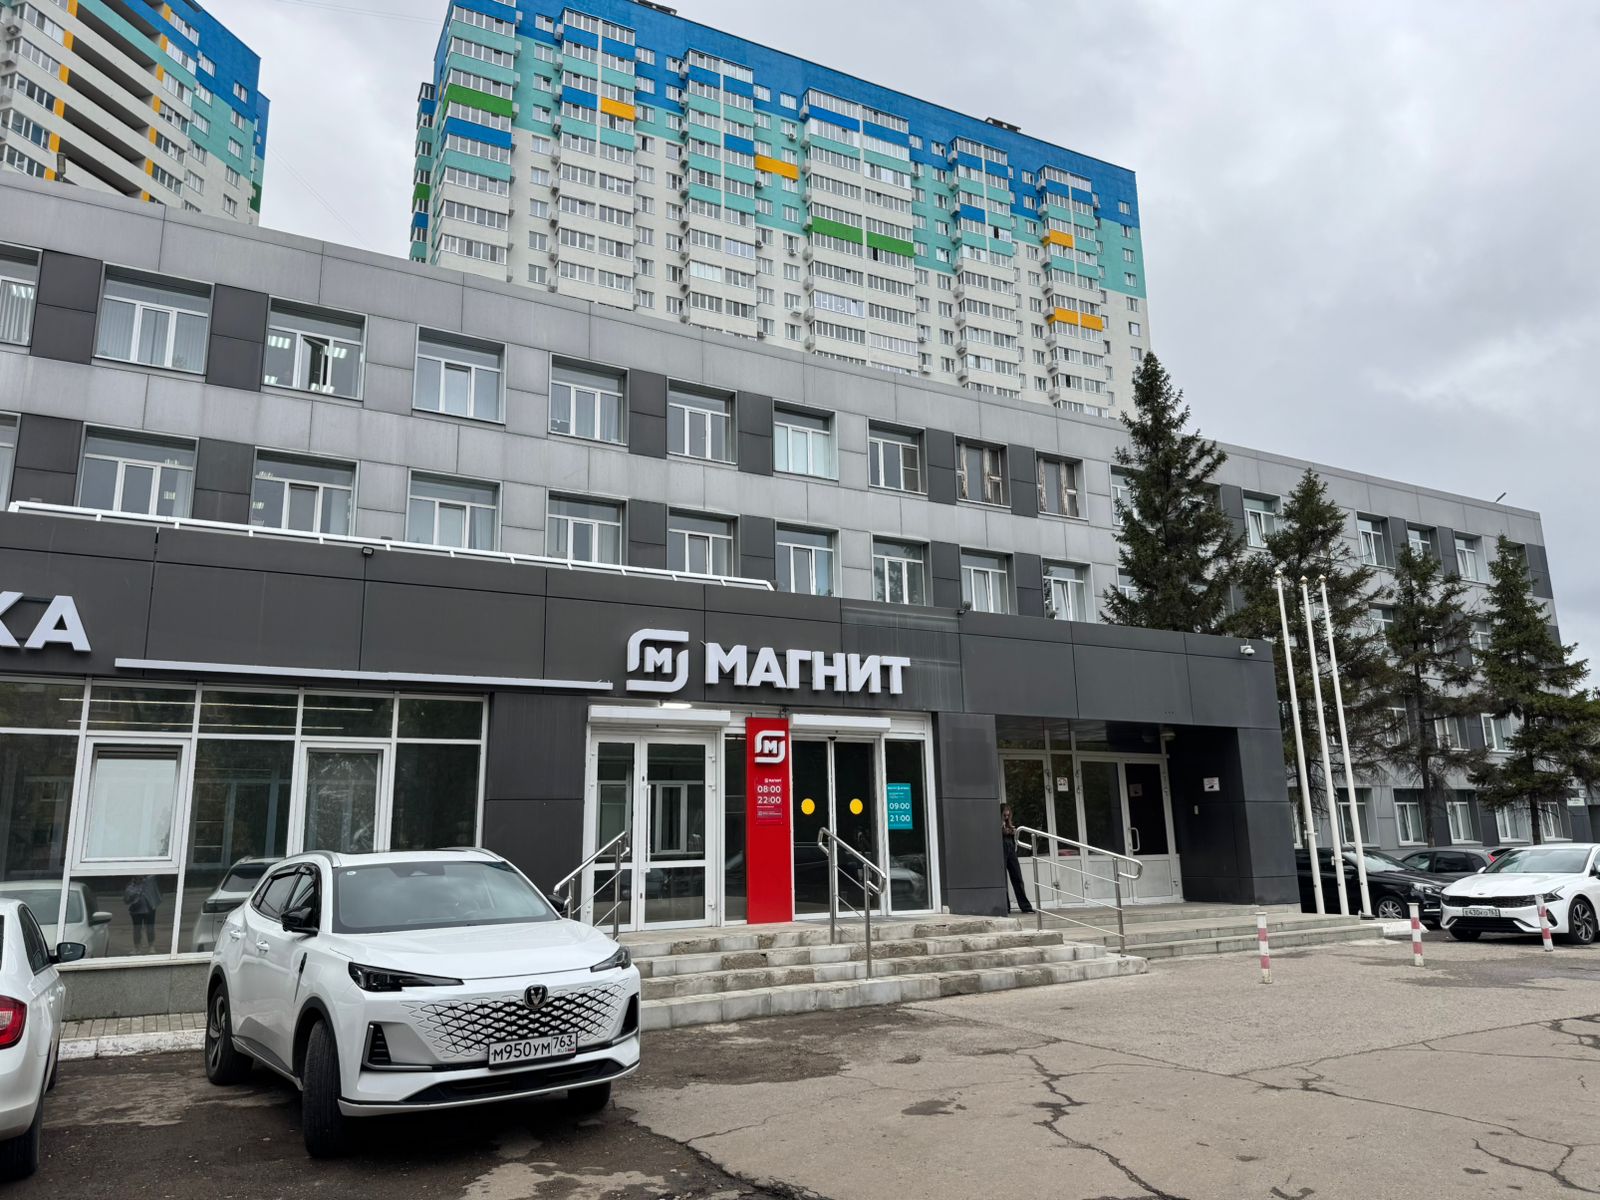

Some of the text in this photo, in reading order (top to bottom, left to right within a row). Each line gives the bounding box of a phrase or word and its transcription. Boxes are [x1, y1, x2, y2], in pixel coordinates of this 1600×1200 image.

[705, 642, 911, 694] МАГНИТ
[493, 1035, 573, 1061] М950УМ 763
